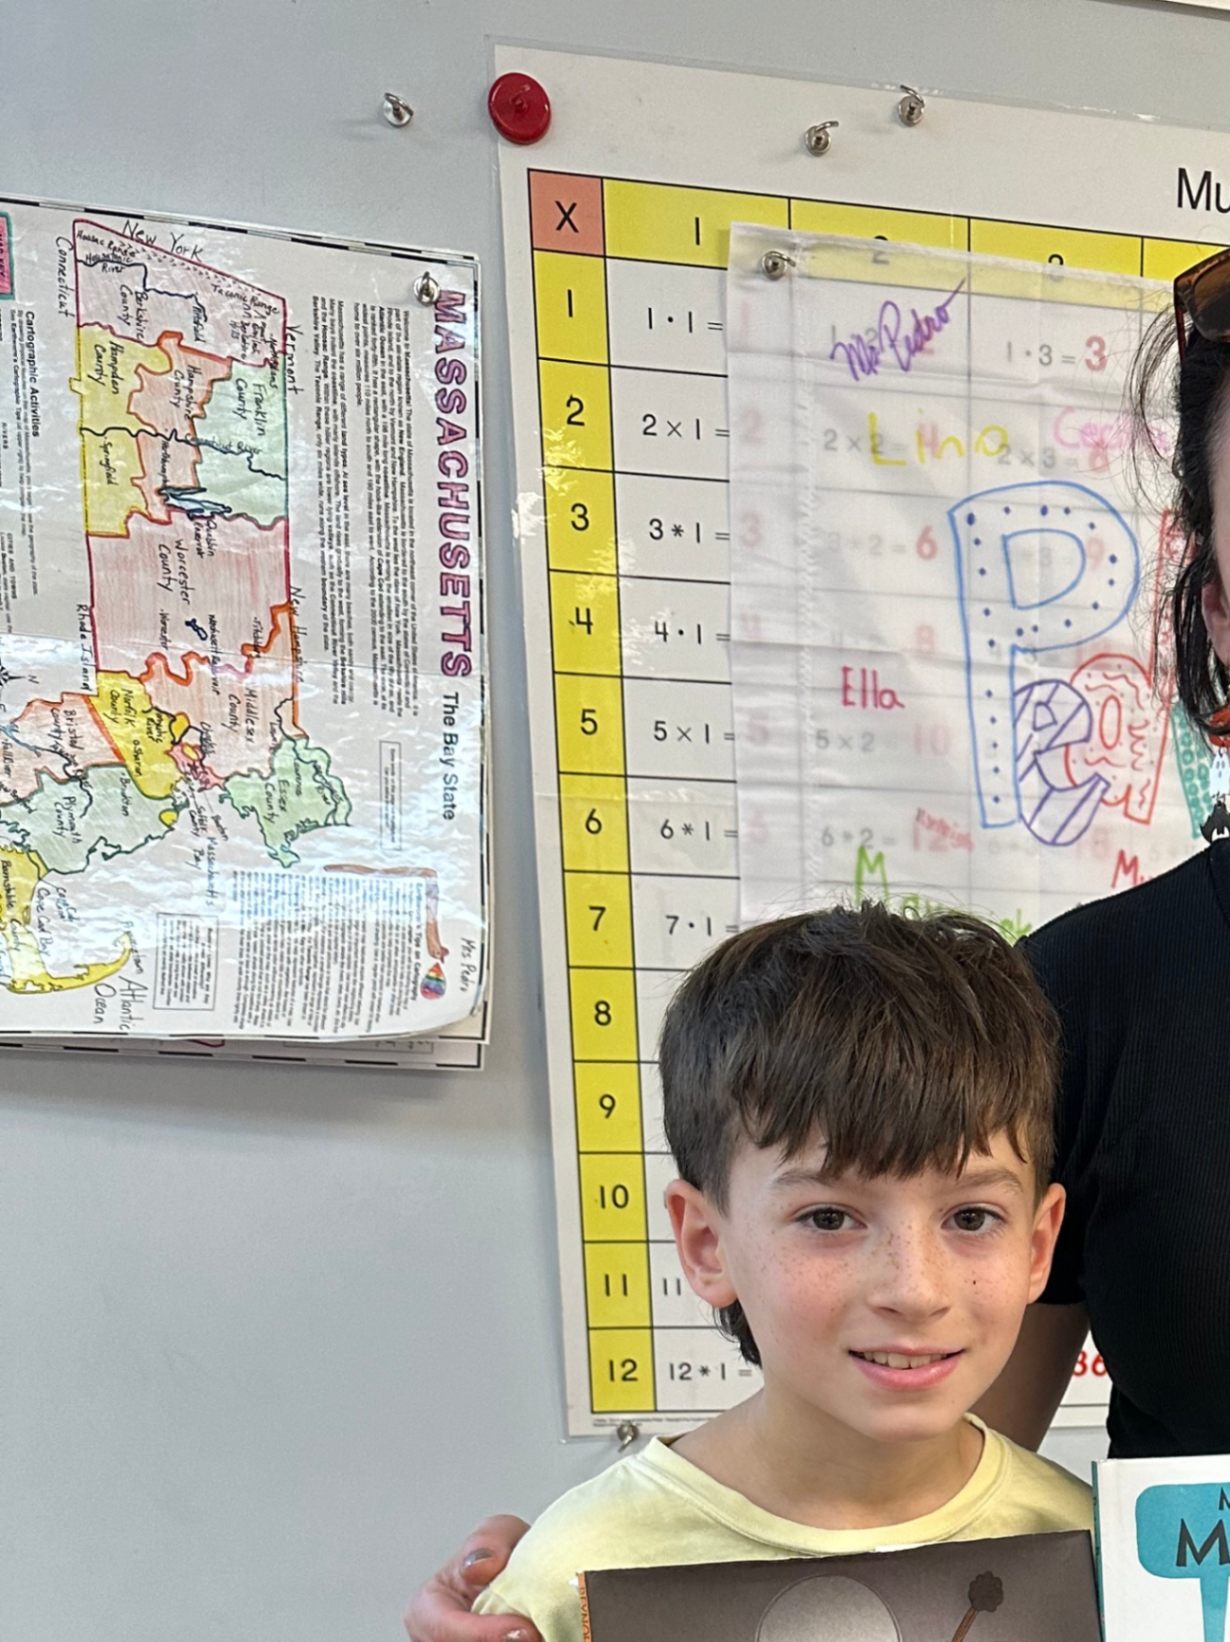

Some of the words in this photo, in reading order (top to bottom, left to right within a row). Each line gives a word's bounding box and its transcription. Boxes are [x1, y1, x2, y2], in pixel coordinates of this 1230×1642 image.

[555, 201, 579, 233] X
[122, 220, 157, 245] New
[170, 232, 204, 263] York
[56, 236, 75, 318] Connecticut
[25, 311, 39, 384] Cartographic
[286, 324, 304, 394] Vermont
[28, 387, 41, 437] Activities
[253, 383, 268, 436] Franklin
[566, 395, 584, 426] 2
[433, 288, 472, 678] MASSACHUSETTS
[571, 503, 589, 531] 3
[156, 544, 176, 592] County
[290, 586, 306, 616] New
[76, 604, 90, 639] Rhode
[576, 607, 593, 635] 4
[80, 644, 96, 691] Island
[842, 666, 905, 709] Ella
[442, 692, 459, 726] The
[581, 709, 597, 735] 5
[438, 732, 458, 766] Bay
[442, 774, 460, 820] State
[585, 809, 602, 834] 6
[589, 906, 606, 931] 7
[93, 982, 116, 1024] Ocean
[118, 976, 148, 1032] Atlantic
[595, 1000, 611, 1026] 8
[599, 1094, 615, 1118] 9
[600, 1184, 629, 1209] 10
[605, 1274, 627, 1297] 11
[609, 1359, 638, 1382] 12
